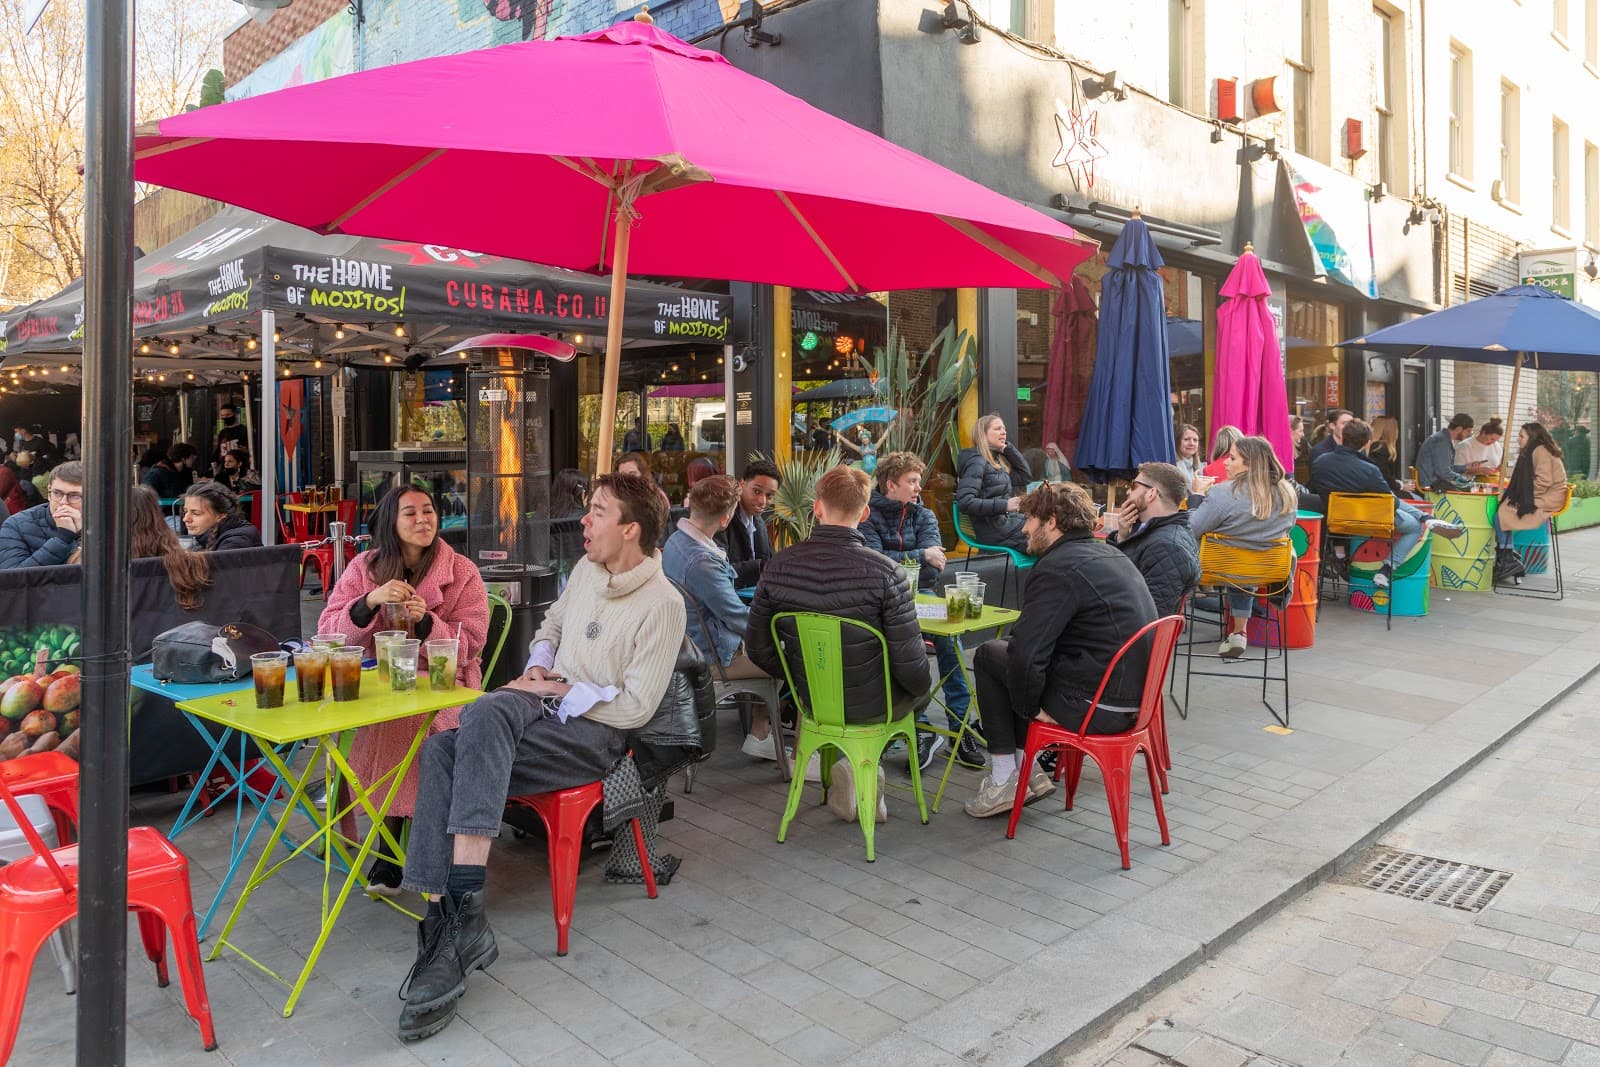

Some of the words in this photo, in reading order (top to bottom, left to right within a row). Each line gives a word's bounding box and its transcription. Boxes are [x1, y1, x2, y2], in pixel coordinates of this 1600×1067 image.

[208, 278, 224, 296] THE
[219, 258, 248, 291] HOME
[292, 264, 331, 284] THE
[331, 257, 393, 291] HOME
[1534, 278, 1559, 288] OOK
[286, 286, 306, 305] OF
[310, 286, 406, 317] MOJITOS!
[446, 280, 607, 320] CUBANA.CO.U
[657, 302, 680, 318] THE
[680, 296, 720, 320] HOME
[654, 320, 666, 334] OF
[669, 315, 728, 341] MOJITOS!
